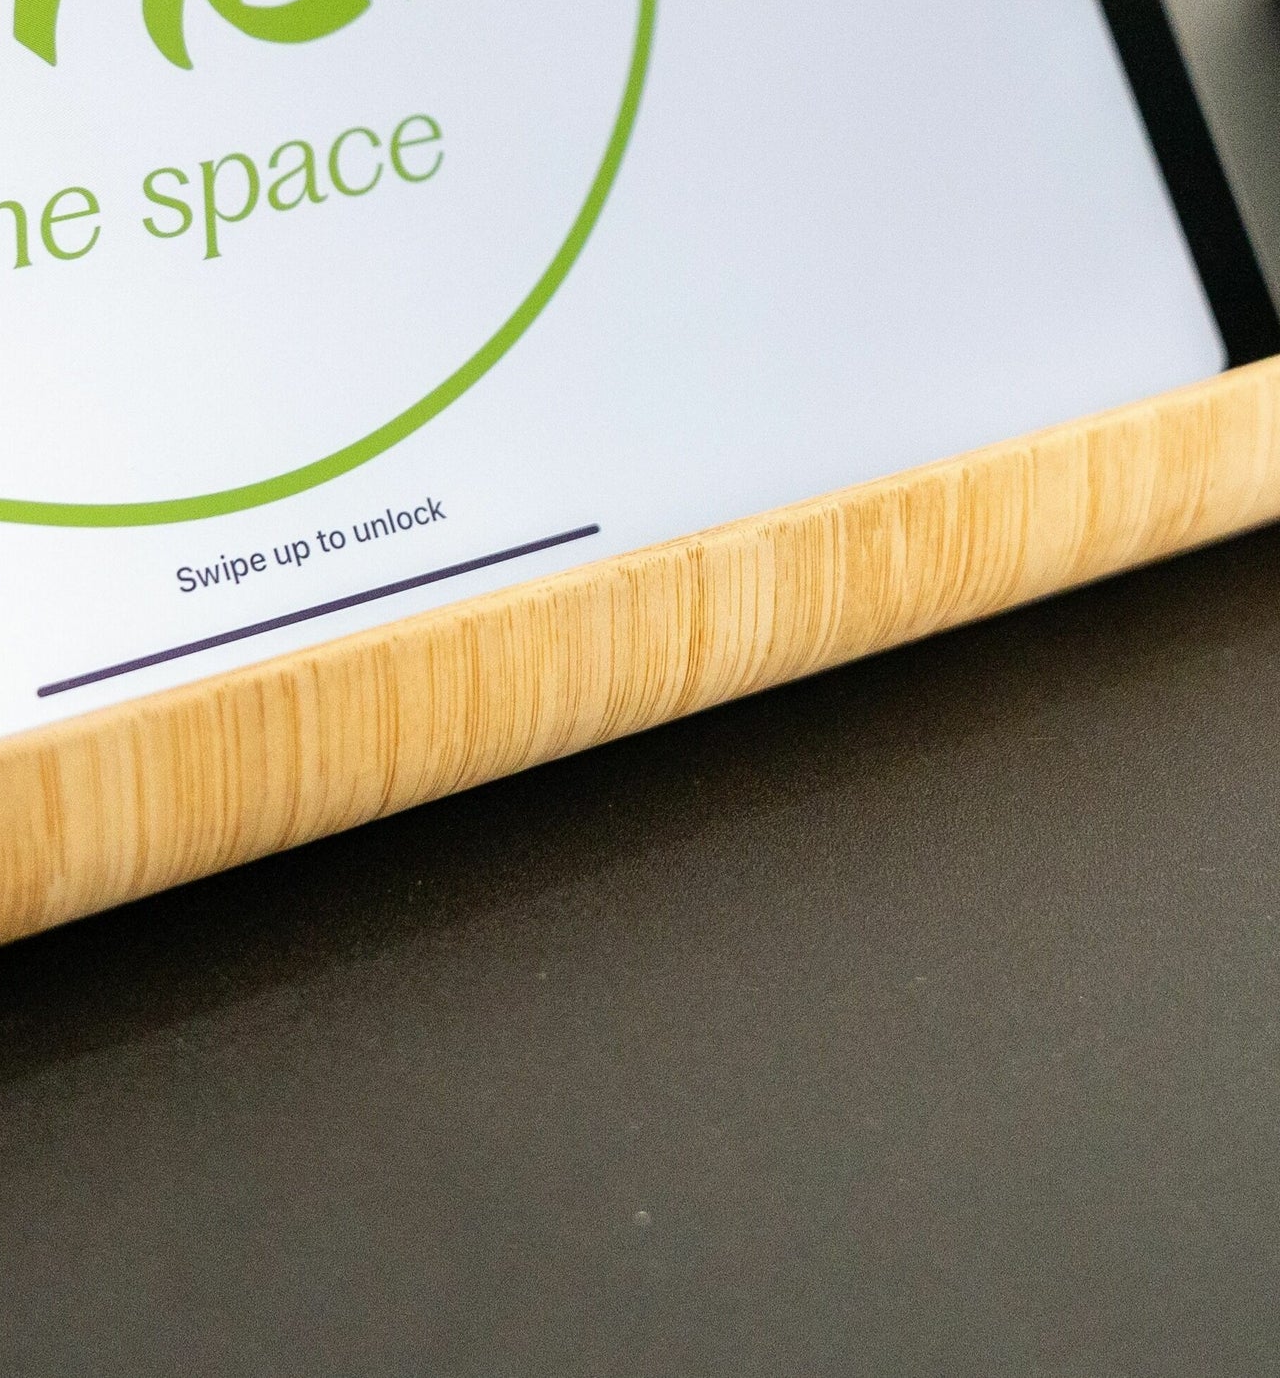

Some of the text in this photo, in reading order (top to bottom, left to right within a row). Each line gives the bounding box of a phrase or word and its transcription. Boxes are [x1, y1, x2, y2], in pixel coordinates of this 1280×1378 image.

[141, 113, 445, 260] space
[176, 497, 448, 593] Swipe up to unlock
